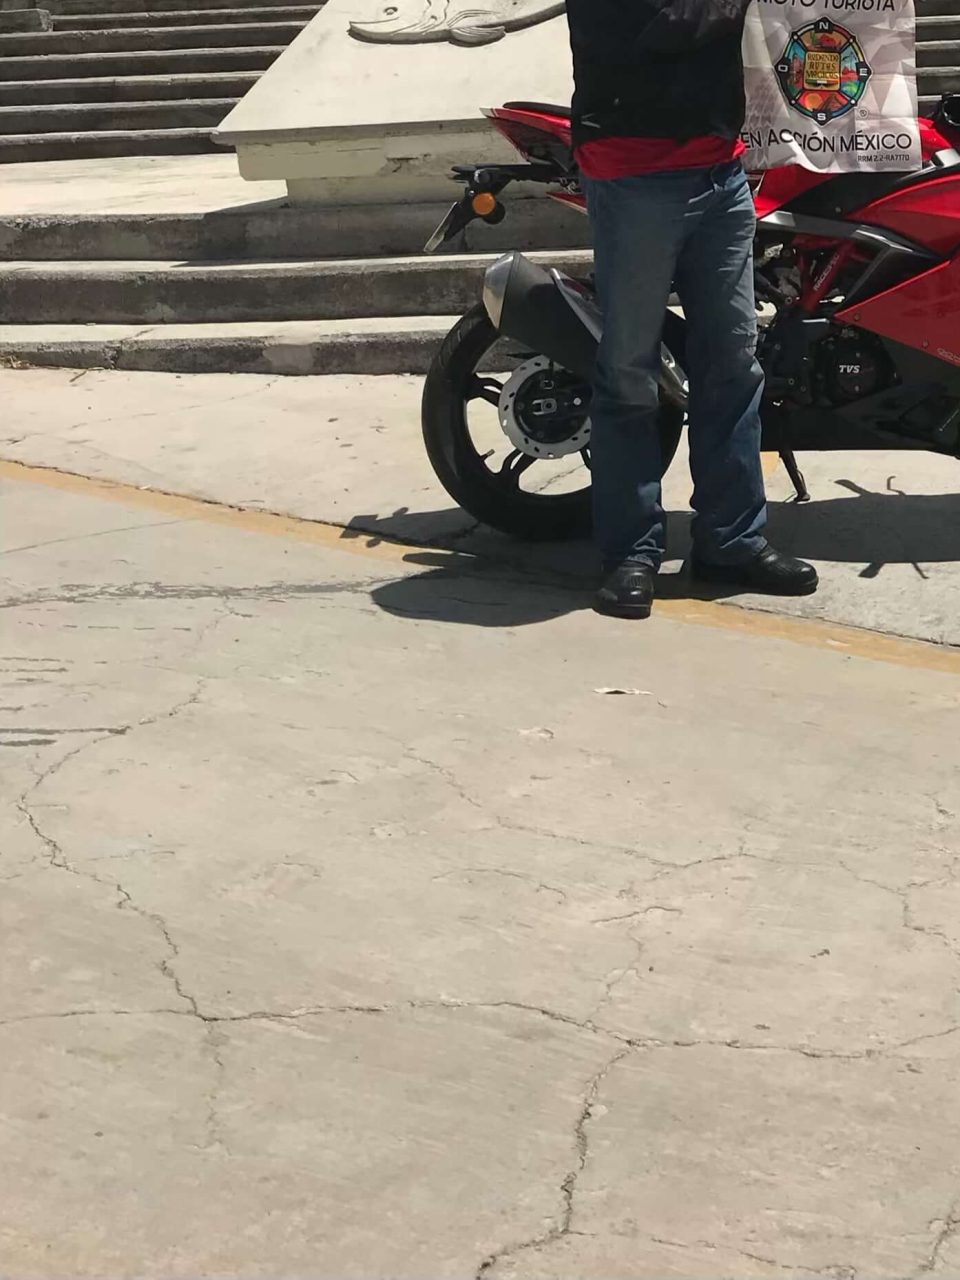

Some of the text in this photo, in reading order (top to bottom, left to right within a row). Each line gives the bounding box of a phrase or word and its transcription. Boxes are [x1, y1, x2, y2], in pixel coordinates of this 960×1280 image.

[819, 21, 829, 29] N
[740, 130, 762, 149] EN
[840, 130, 912, 153] MÉXICO
[839, 365, 861, 374] TVS
